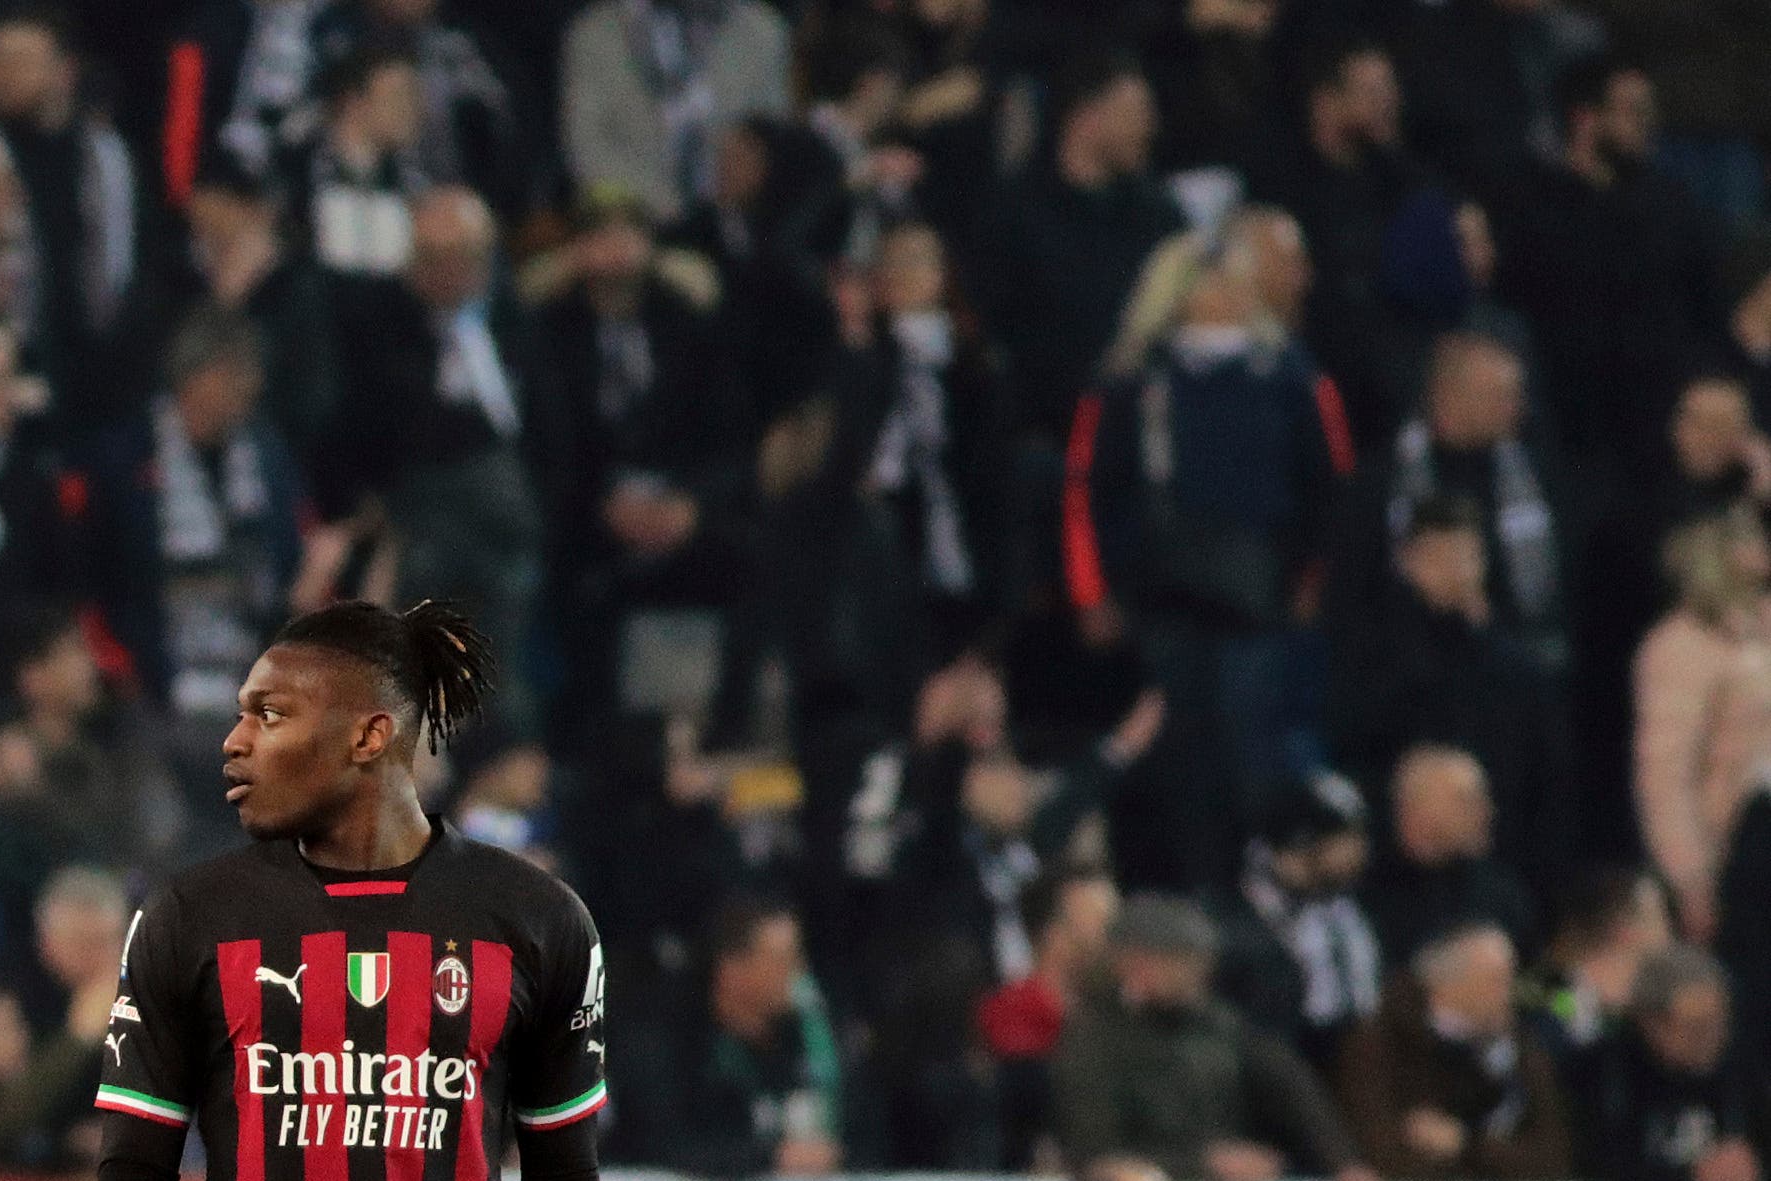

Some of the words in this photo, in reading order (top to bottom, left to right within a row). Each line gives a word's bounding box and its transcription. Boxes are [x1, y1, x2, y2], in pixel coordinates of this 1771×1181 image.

[247, 1040, 476, 1100] Emirates
[279, 1105, 333, 1147] FLY
[343, 1105, 448, 1150] BETTER
